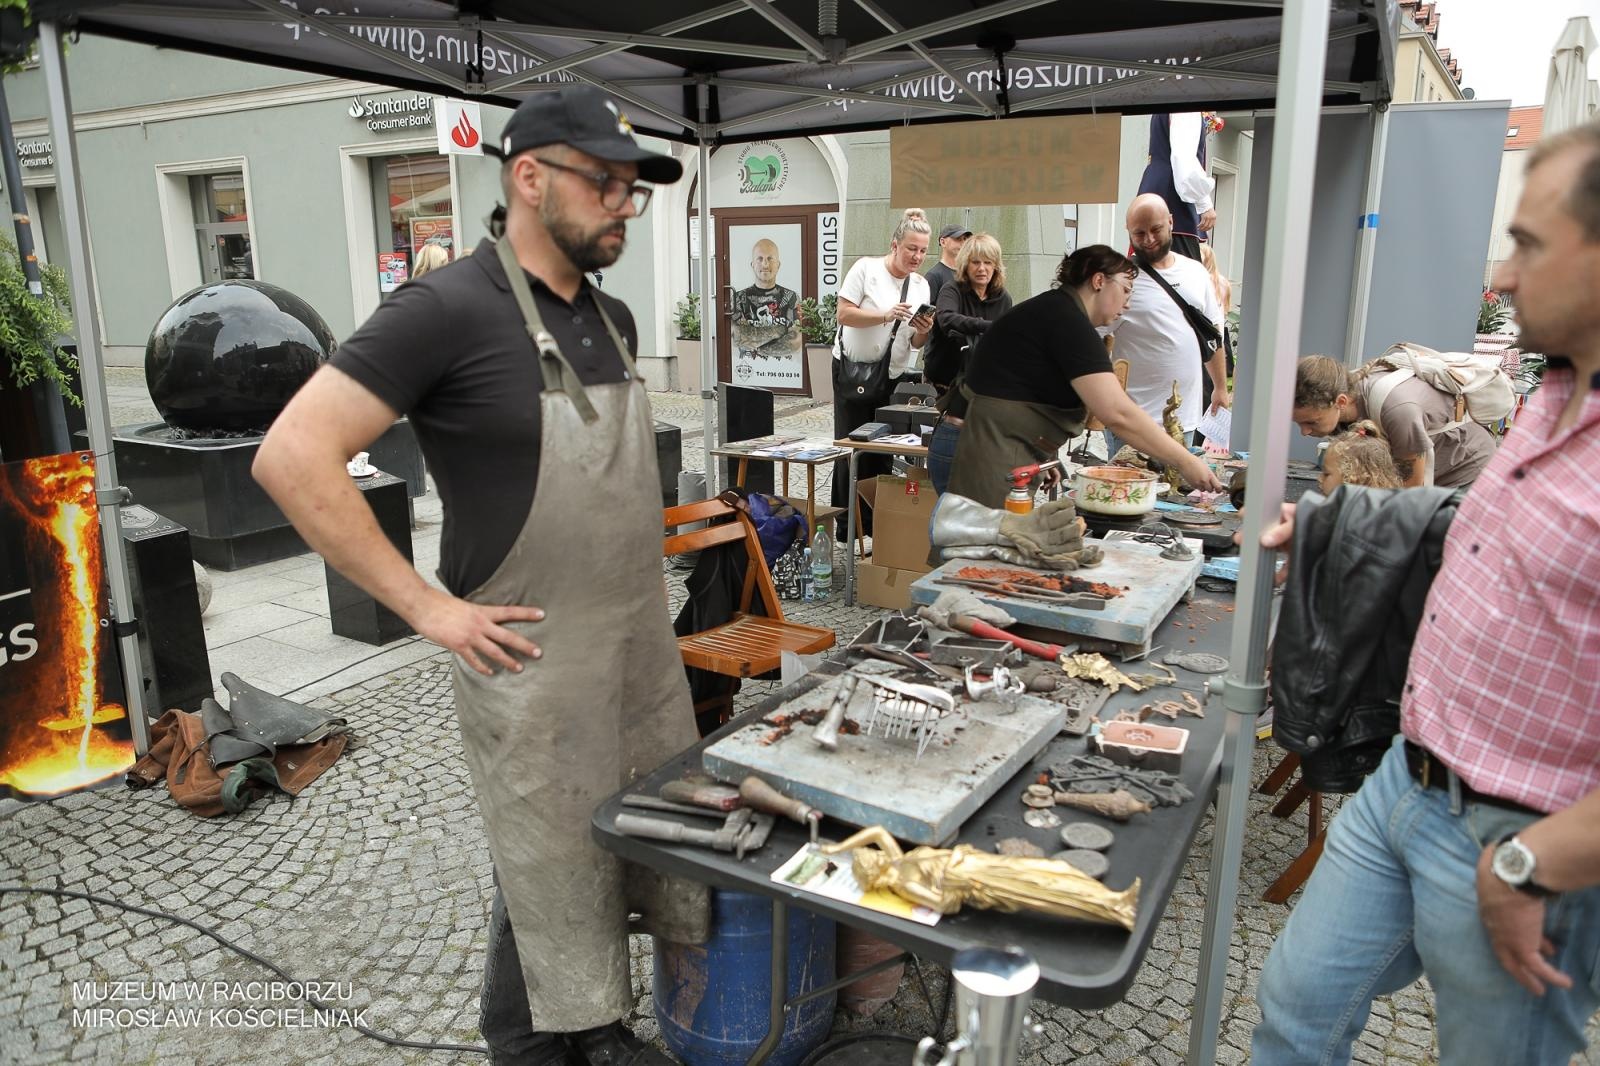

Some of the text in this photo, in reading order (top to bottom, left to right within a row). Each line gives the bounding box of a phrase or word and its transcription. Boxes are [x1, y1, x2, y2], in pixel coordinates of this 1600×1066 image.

[366, 95, 432, 116] Santander
[367, 113, 432, 131] Consumer Bank
[823, 216, 837, 285] STUDIO
[0, 622, 39, 667] S
